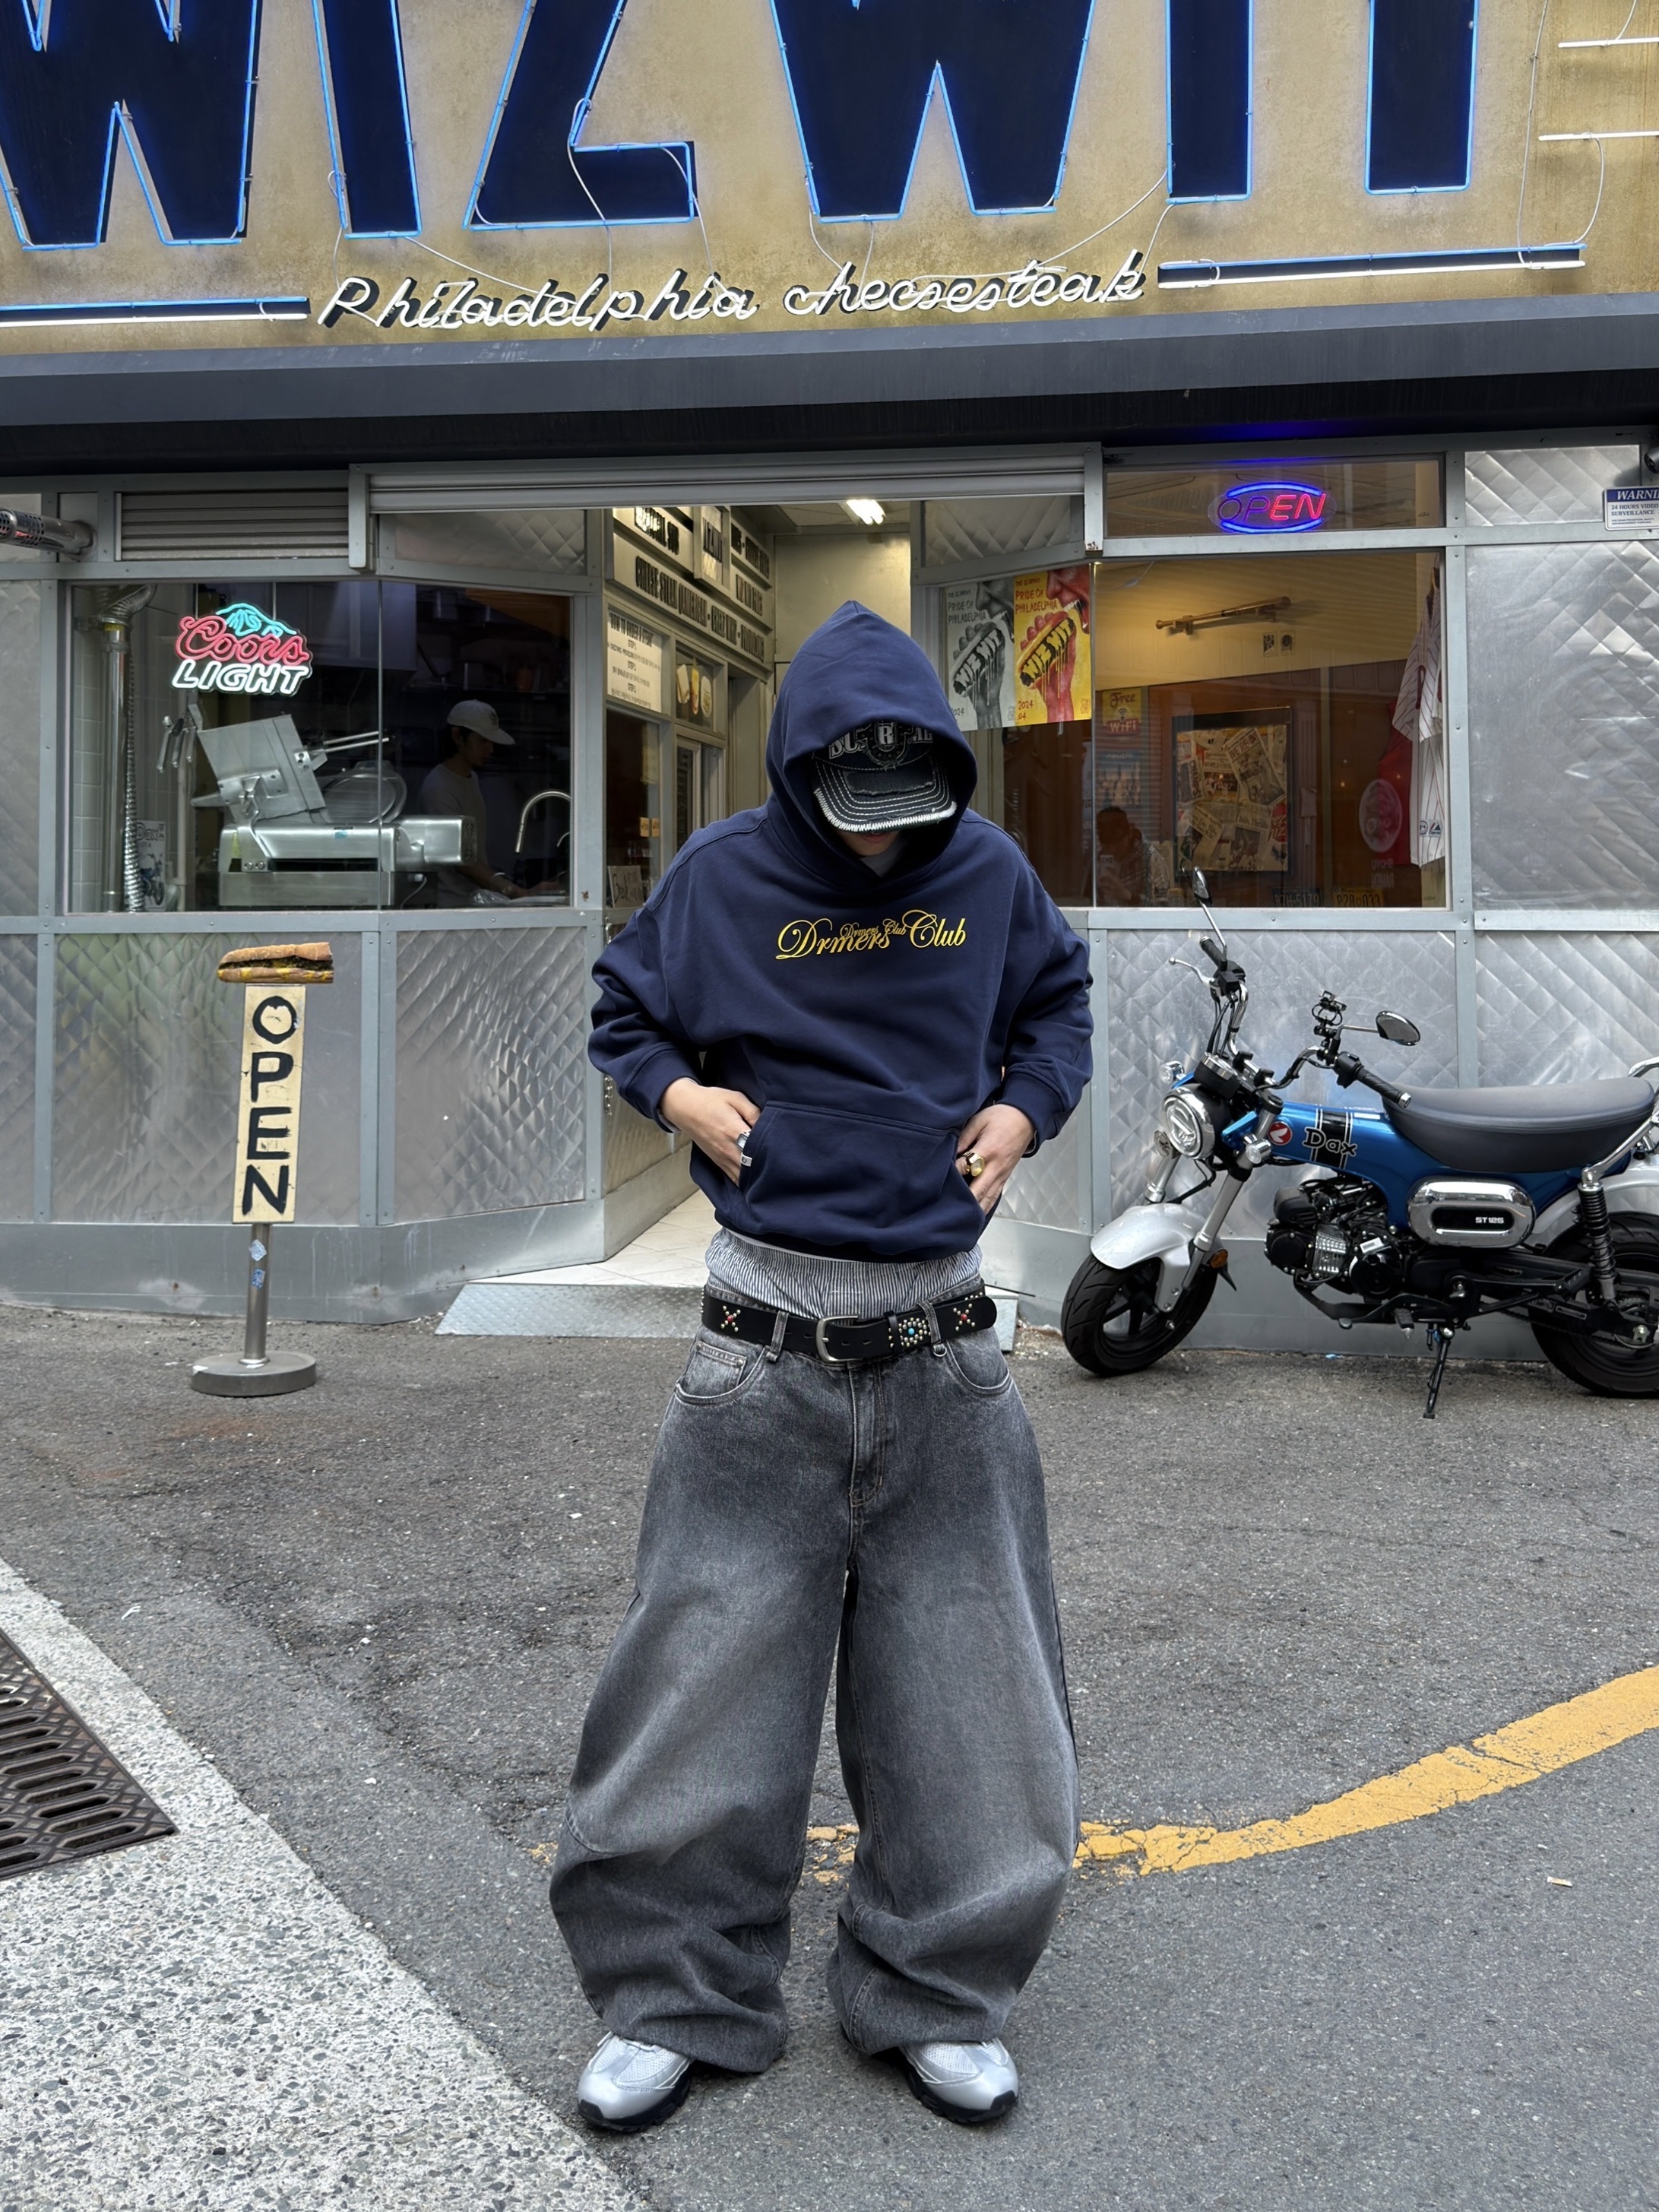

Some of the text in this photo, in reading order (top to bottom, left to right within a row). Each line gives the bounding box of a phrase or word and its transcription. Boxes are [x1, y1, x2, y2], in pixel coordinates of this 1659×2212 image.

[317, 249, 1146, 333] Philadelphia cheesesteak
[1617, 489, 1659, 501] WARNI
[1217, 493, 1327, 522] OPEN
[1015, 588, 1044, 601] PRIDE OF
[948, 600, 974, 611] PRIDE OF
[1015, 600, 1058, 615] PHILADELPHIA
[948, 611, 986, 626] PHILADELPHIA
[176, 615, 310, 666] Coors
[172, 658, 309, 694] LIGHT
[1018, 699, 1034, 711] 2024
[1110, 692, 1136, 708] Free
[951, 707, 964, 716] 024
[882, 918, 907, 936] Club
[902, 909, 967, 949] Club
[242, 995, 298, 1216] OPEN
[1302, 1127, 1357, 1157] Dax
